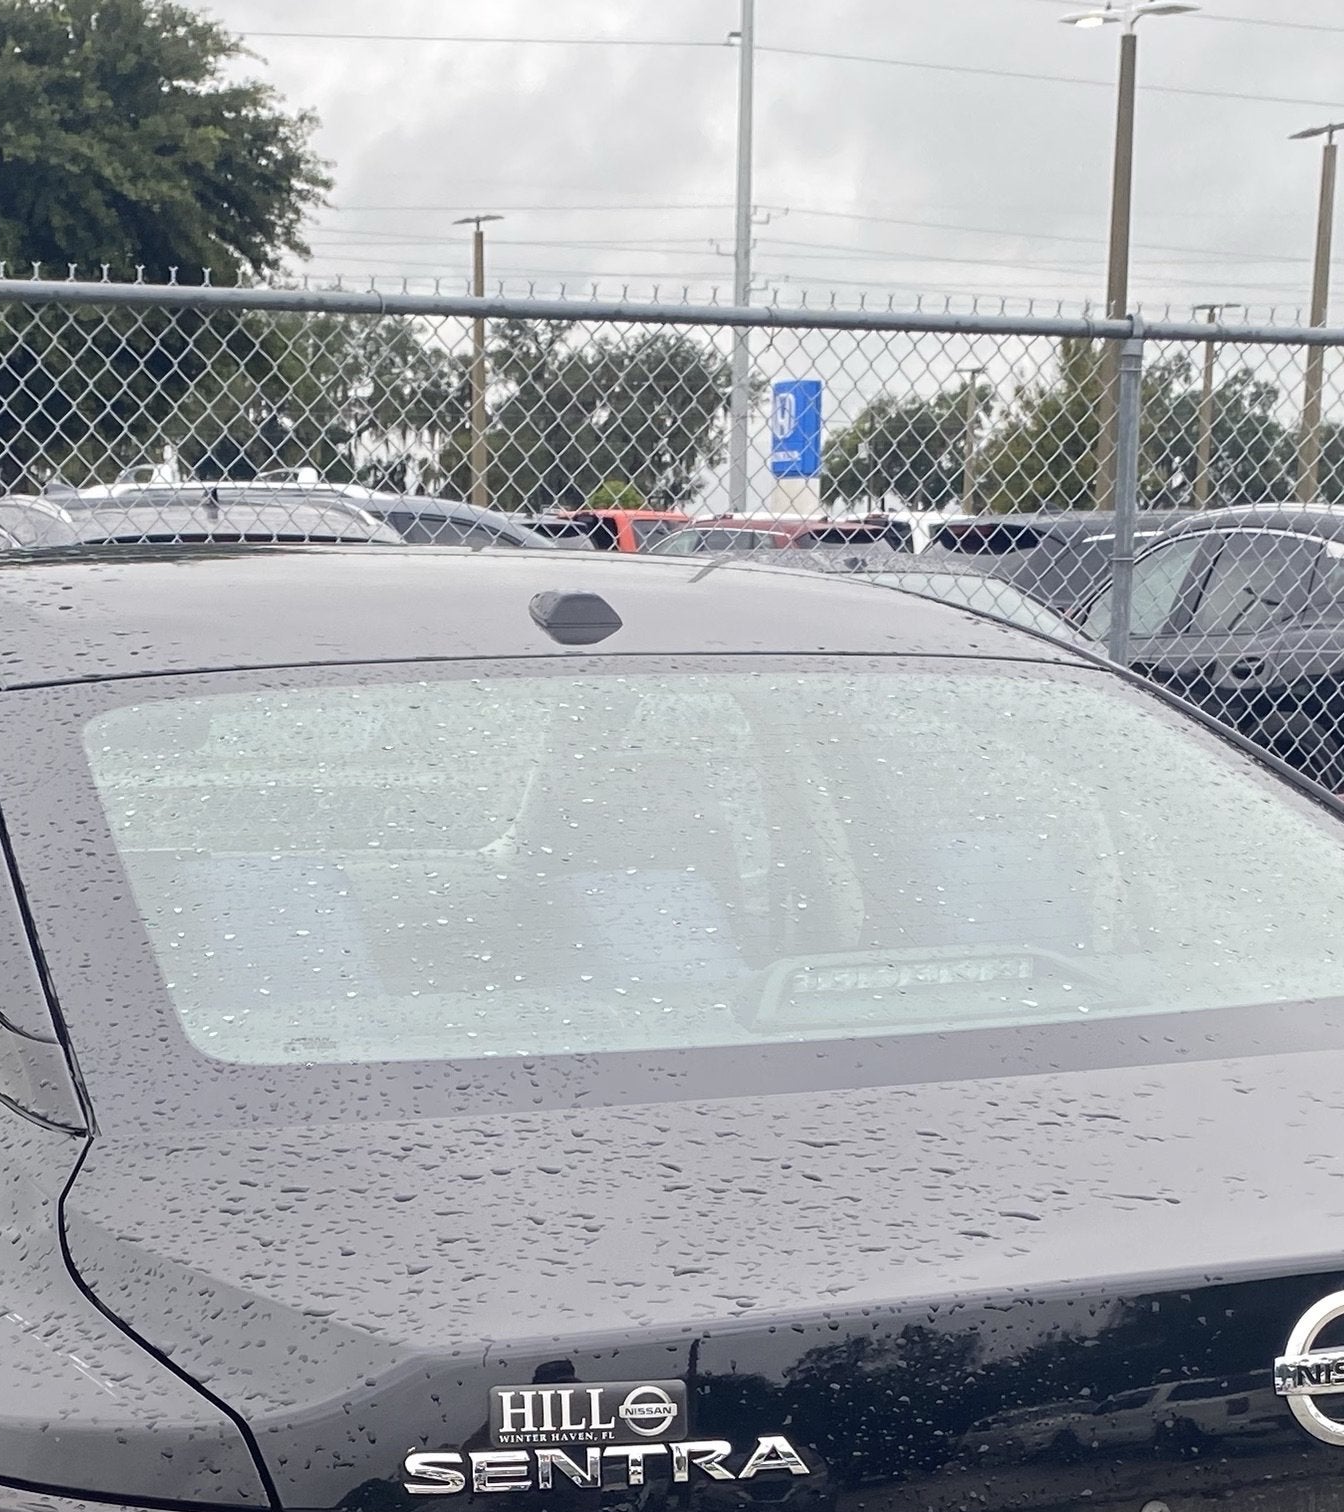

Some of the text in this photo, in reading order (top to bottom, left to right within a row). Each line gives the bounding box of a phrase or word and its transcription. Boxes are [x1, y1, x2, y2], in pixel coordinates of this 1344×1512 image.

[497, 1387, 616, 1433] HILL
[624, 1405, 673, 1416] NISSAN
[498, 1431, 616, 1444] WINTER HAVEN, FL
[402, 1434, 811, 1495] SENTRA
